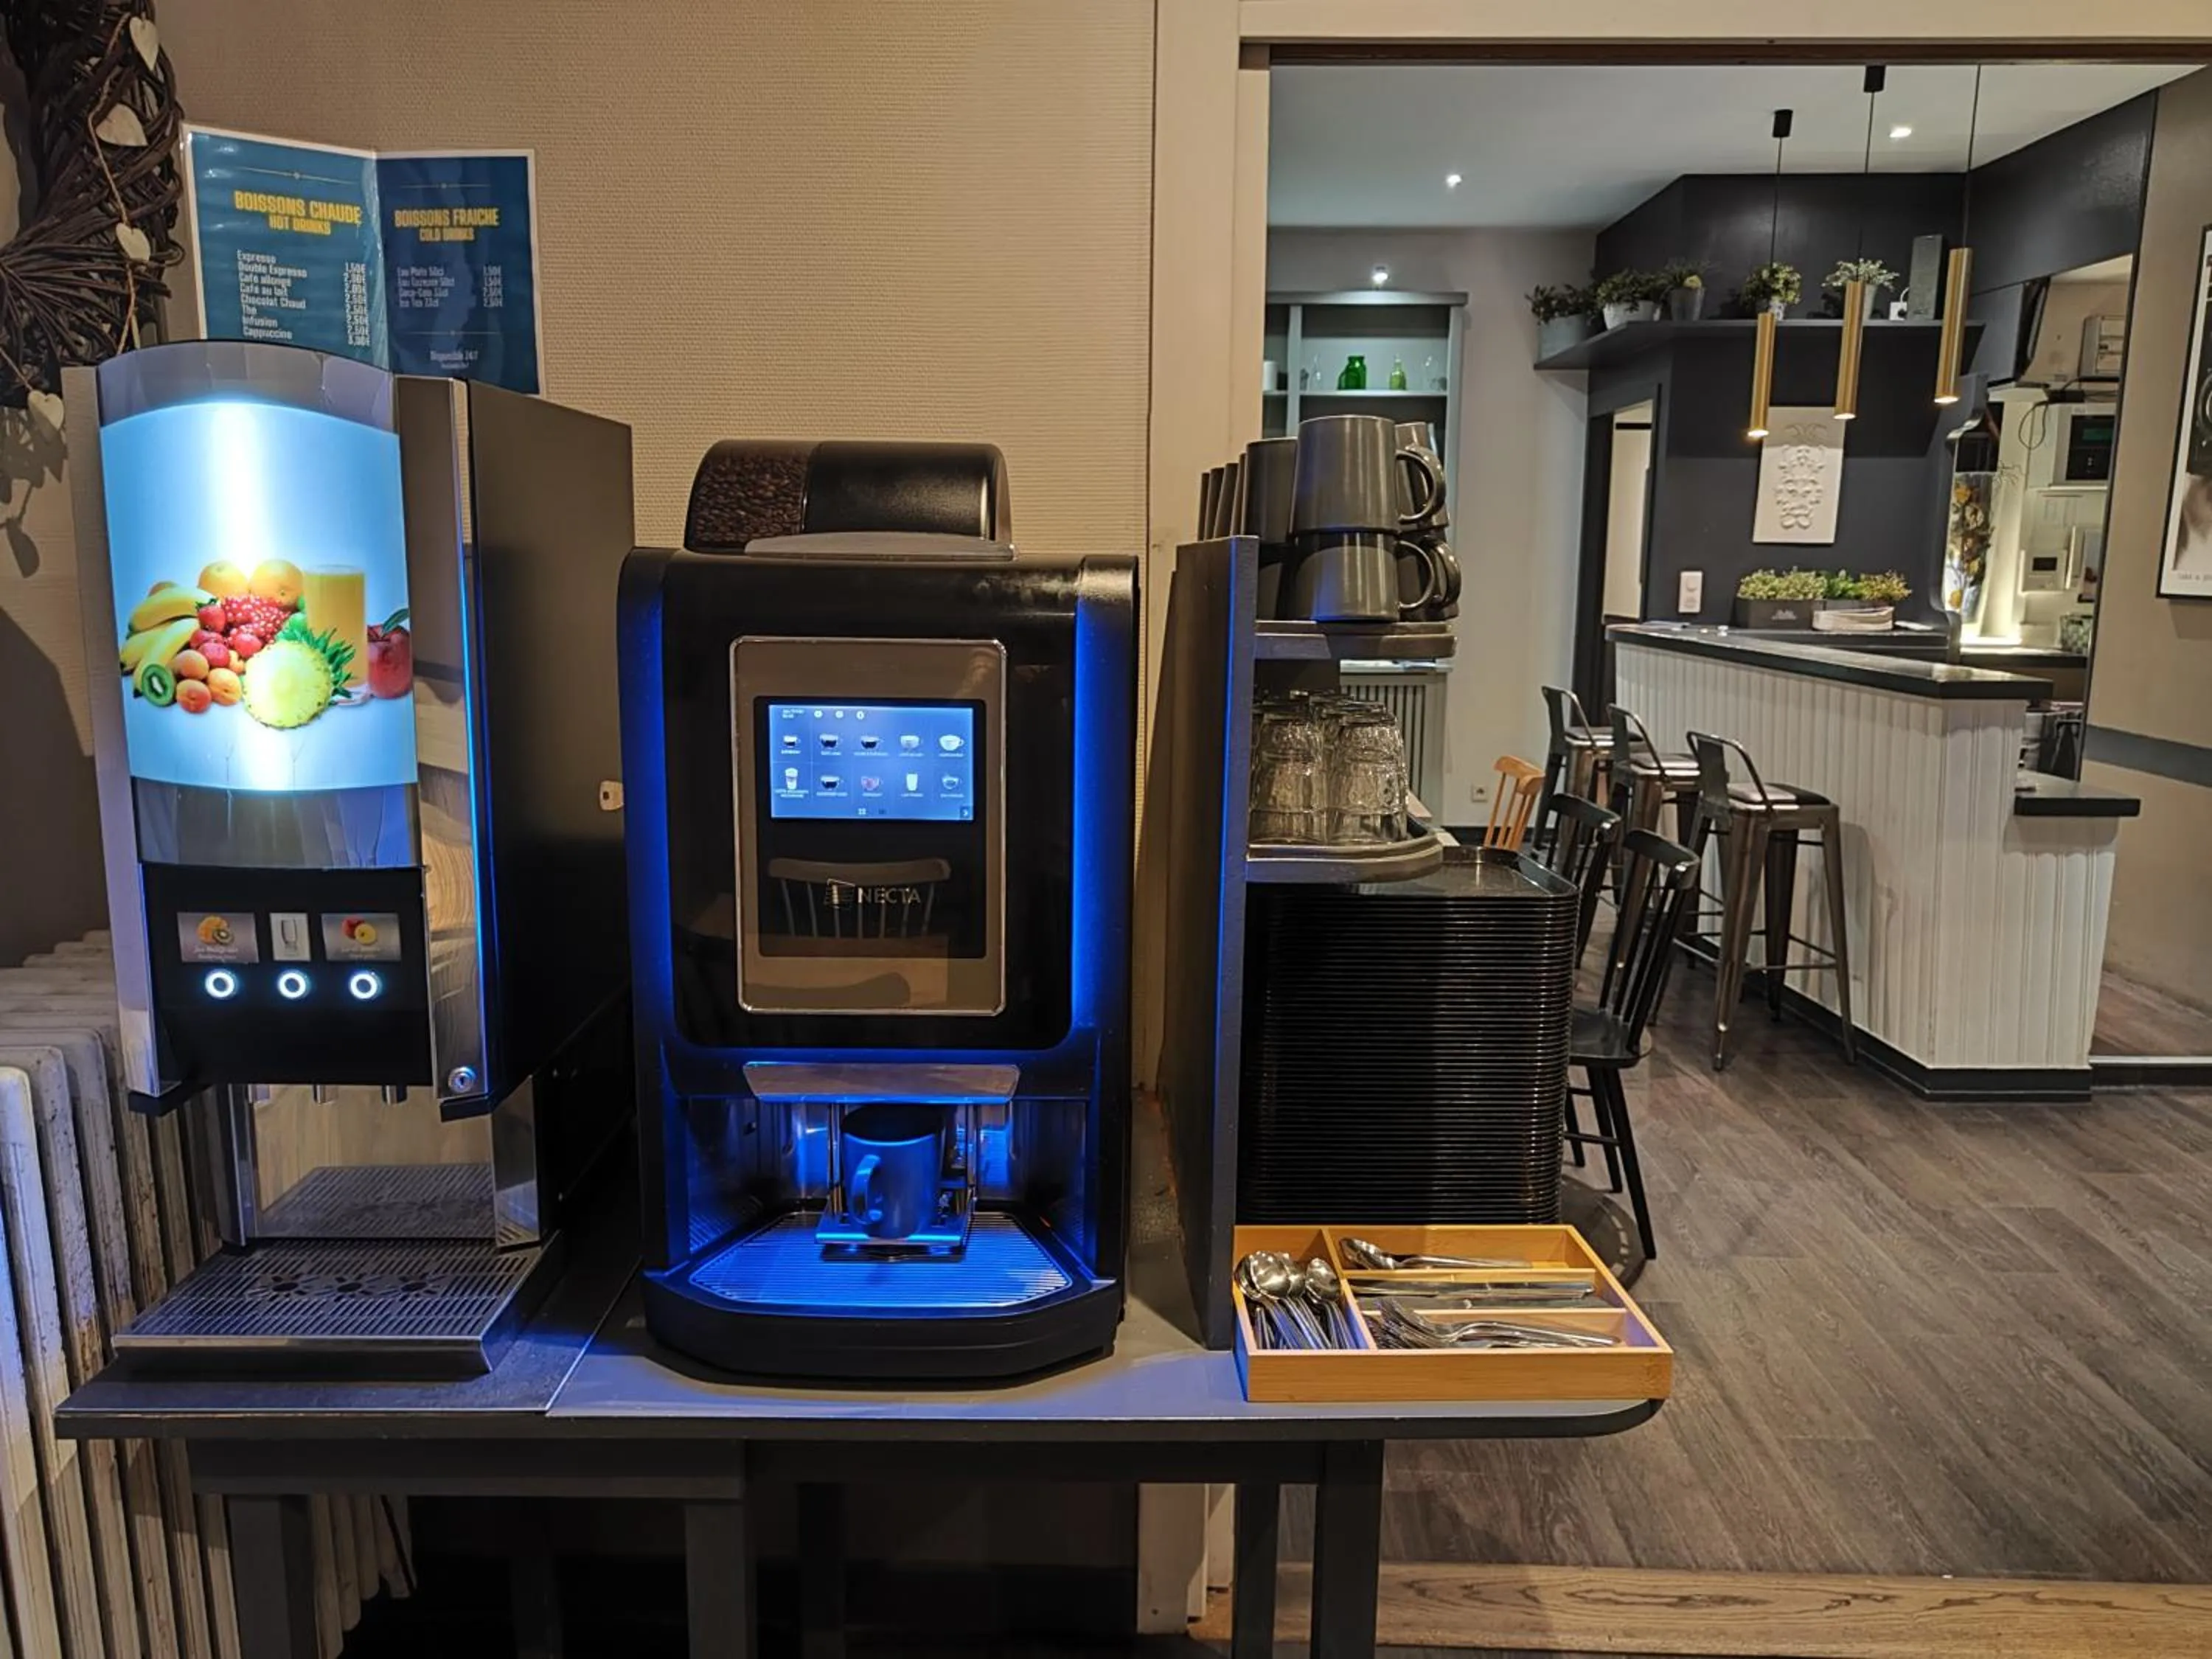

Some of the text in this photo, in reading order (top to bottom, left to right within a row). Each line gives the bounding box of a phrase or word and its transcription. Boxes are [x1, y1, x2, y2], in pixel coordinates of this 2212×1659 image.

[234, 190, 305, 216] BOISSONS
[268, 214, 331, 235] HOT DRINKS
[394, 209, 449, 228] BOISSONS
[240, 293, 278, 307] Chocolat
[242, 316, 277, 327] Infusion
[858, 887, 921, 904] NECTA
